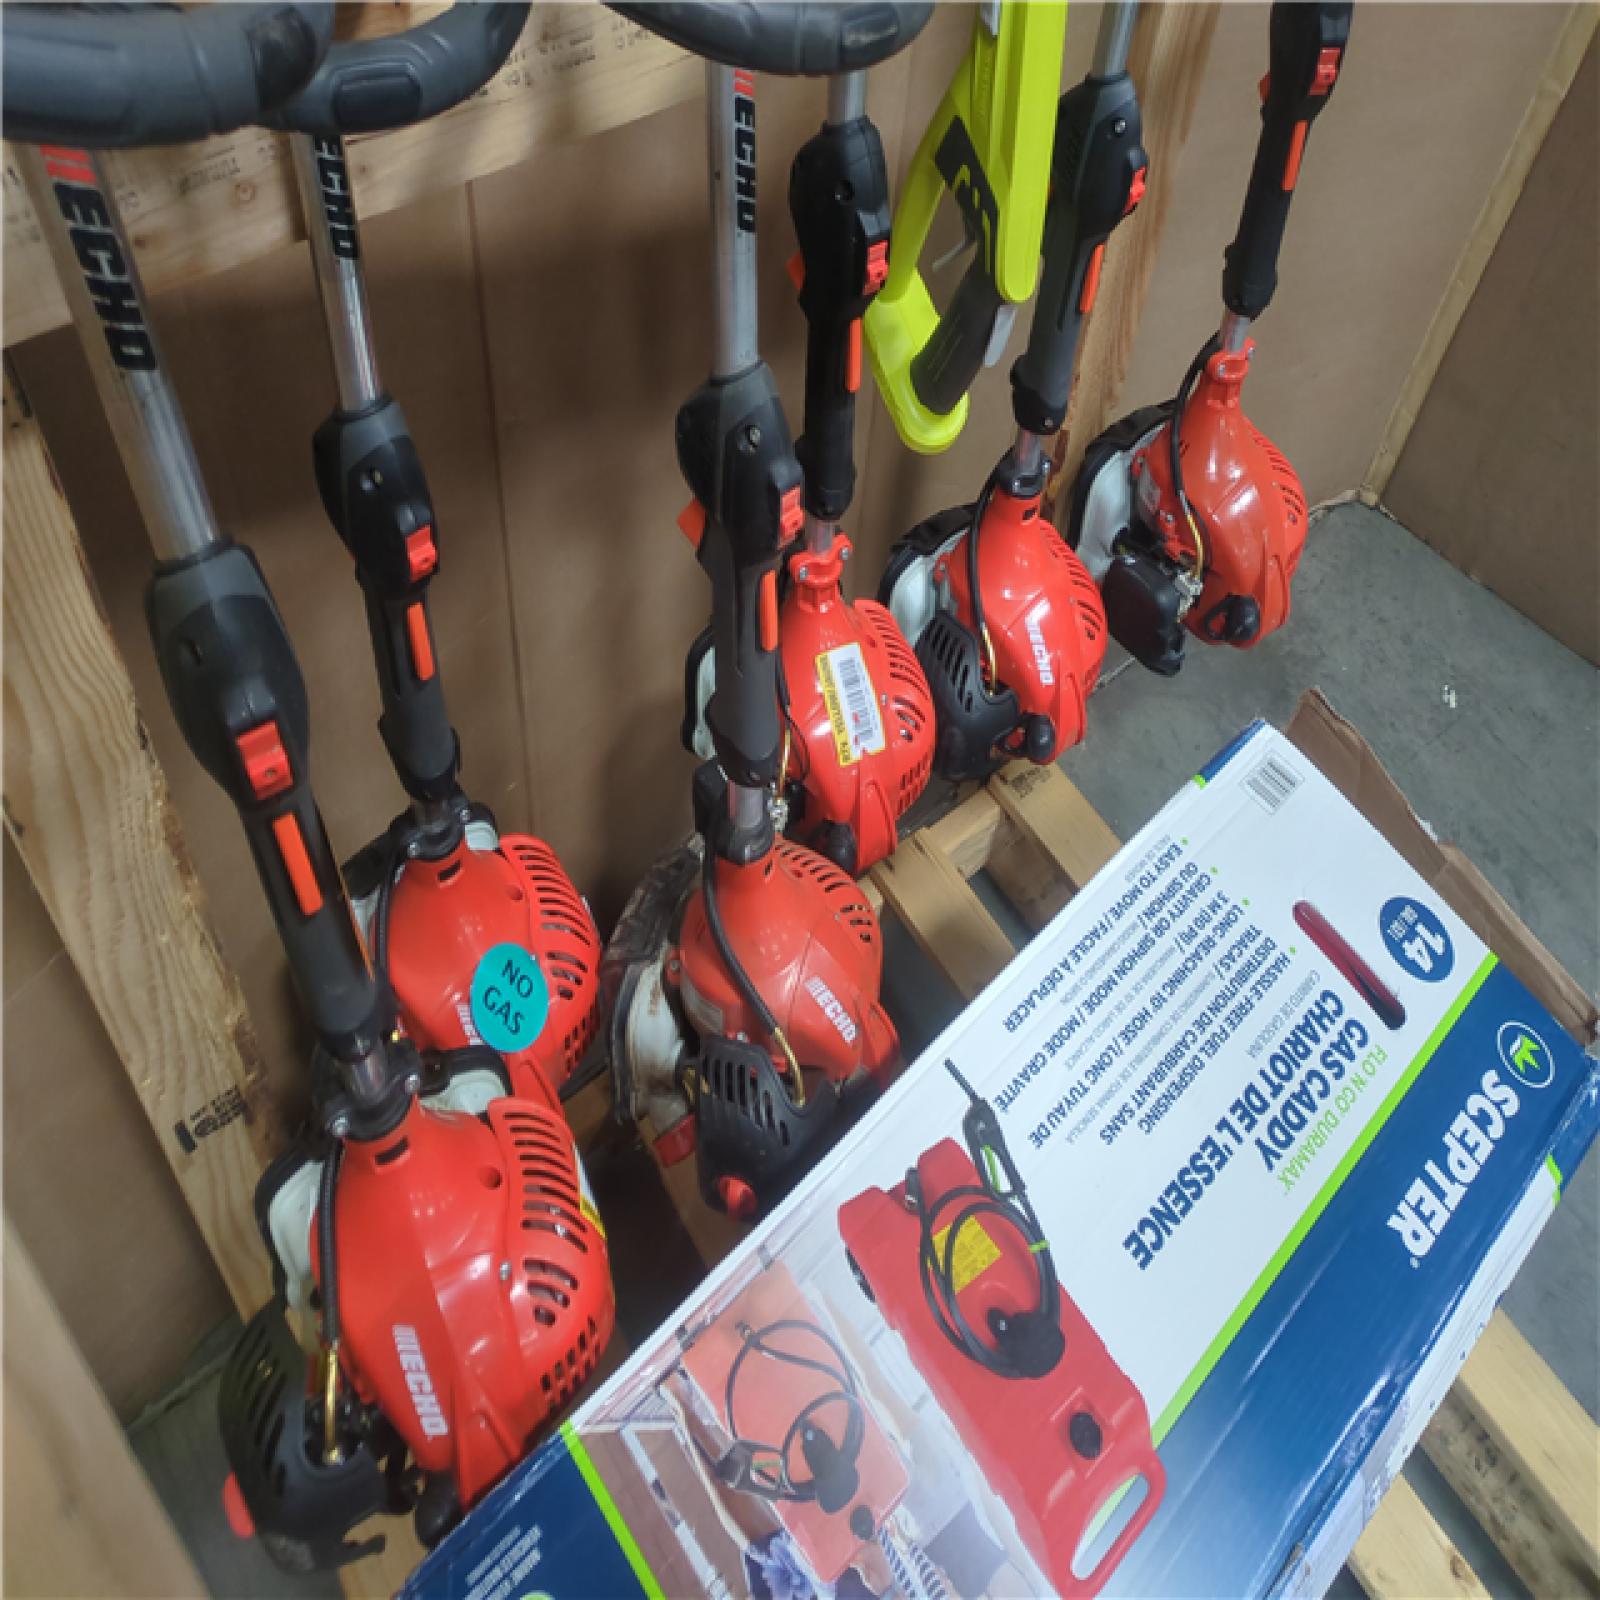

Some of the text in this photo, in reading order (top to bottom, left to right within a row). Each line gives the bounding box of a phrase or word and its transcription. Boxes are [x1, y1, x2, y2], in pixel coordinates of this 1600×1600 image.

[735, 97, 756, 233] ECHO
[54, 183, 156, 371] ECHO
[1029, 630, 1055, 686] ECHO
[1139, 871, 1158, 888] TO
[1153, 843, 1183, 875] EASY
[1179, 862, 1198, 883] OU
[1108, 885, 1143, 920] MOVE
[1142, 877, 1183, 922] SIPHON
[1167, 873, 1211, 922] GRAVITY
[1207, 899, 1222, 915] M
[1217, 891, 1229, 904] 3
[1068, 921, 1108, 964] FACILE
[1151, 917, 1170, 938] OR
[1218, 925, 1262, 971] TRACAS
[1404, 924, 1446, 973] 14
[502, 958, 533, 998] NO
[1059, 958, 1073, 972] À
[1113, 933, 1155, 980] SIPHON
[483, 985, 525, 1035] GAS
[816, 989, 857, 1044] ECHO
[1003, 968, 1064, 1032] DÉPLACER
[1082, 975, 1118, 1015] MODE
[1043, 1015, 1080, 1057] MODE
[1100, 937, 1277, 1145] DISTRIBUTION DE CARBURANT SANS
[1118, 1007, 1153, 1045] HOSE
[1138, 952, 1290, 1134] HASSLE-FREE FUEL DISPENSING
[1259, 990, 1343, 1100] CHARIOT
[993, 1052, 1047, 1113] GRAVITÉ
[1085, 1045, 1121, 1085] LONG
[1361, 1045, 1388, 1077] FLO
[1047, 1080, 1090, 1128] TUYAU
[1230, 1082, 1270, 1133] DE
[1255, 1019, 1368, 1171] GAS CADDY
[1029, 1122, 1051, 1148] DE
[1387, 1070, 1520, 1257] SCEPTER
[400, 1353, 448, 1436] ECHO
